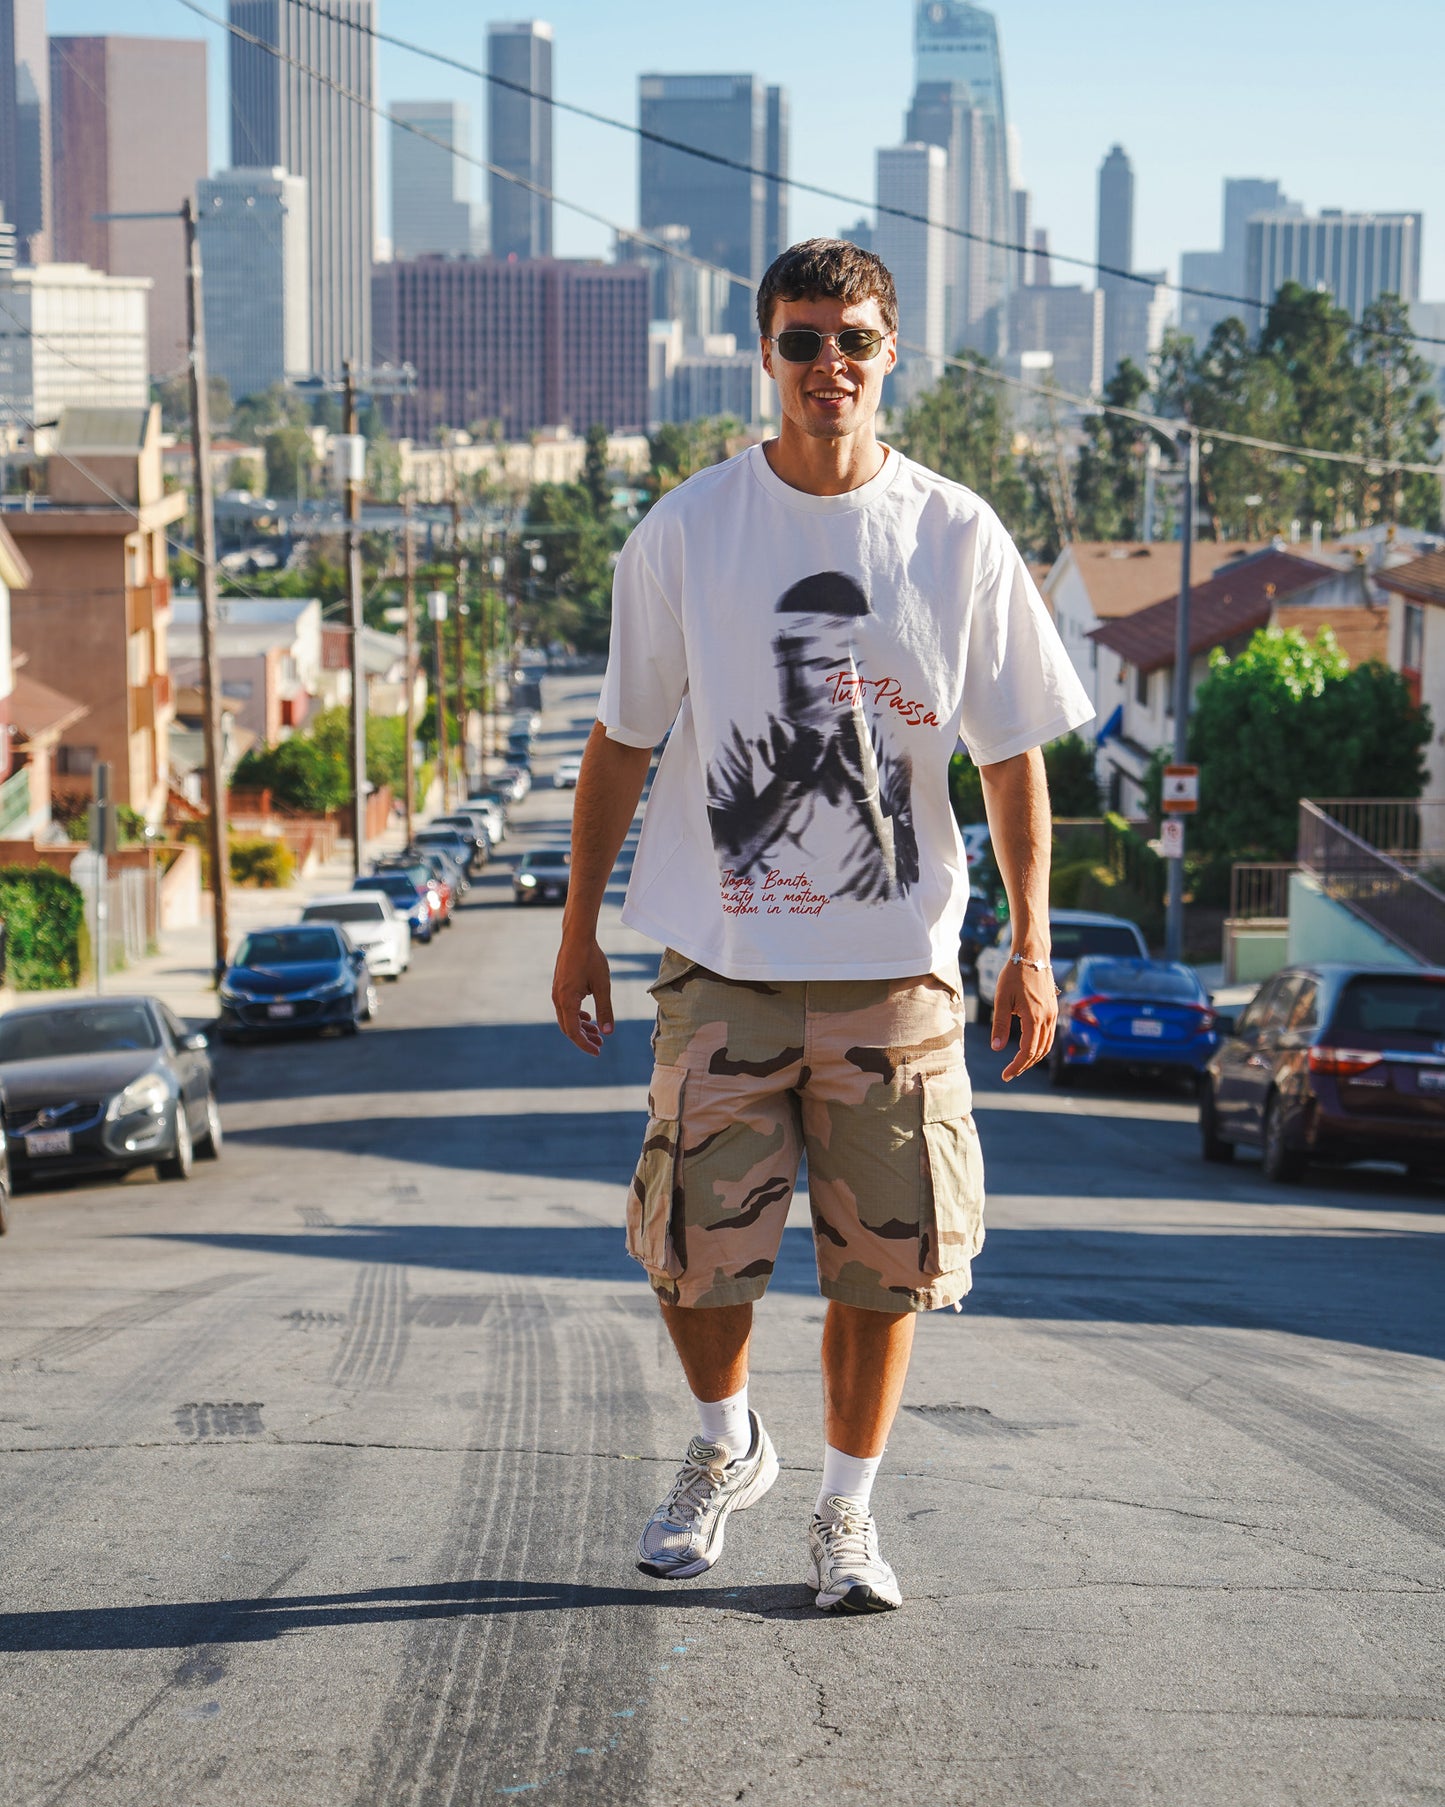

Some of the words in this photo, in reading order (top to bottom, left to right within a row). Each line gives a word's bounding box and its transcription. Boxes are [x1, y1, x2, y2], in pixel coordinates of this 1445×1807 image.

[825, 671, 868, 707] Tutto
[873, 677, 939, 727] Passa
[761, 869, 814, 890] Bonito:
[761, 892, 777, 902] in
[767, 904, 781, 914] in
[788, 902, 825, 917] mind
